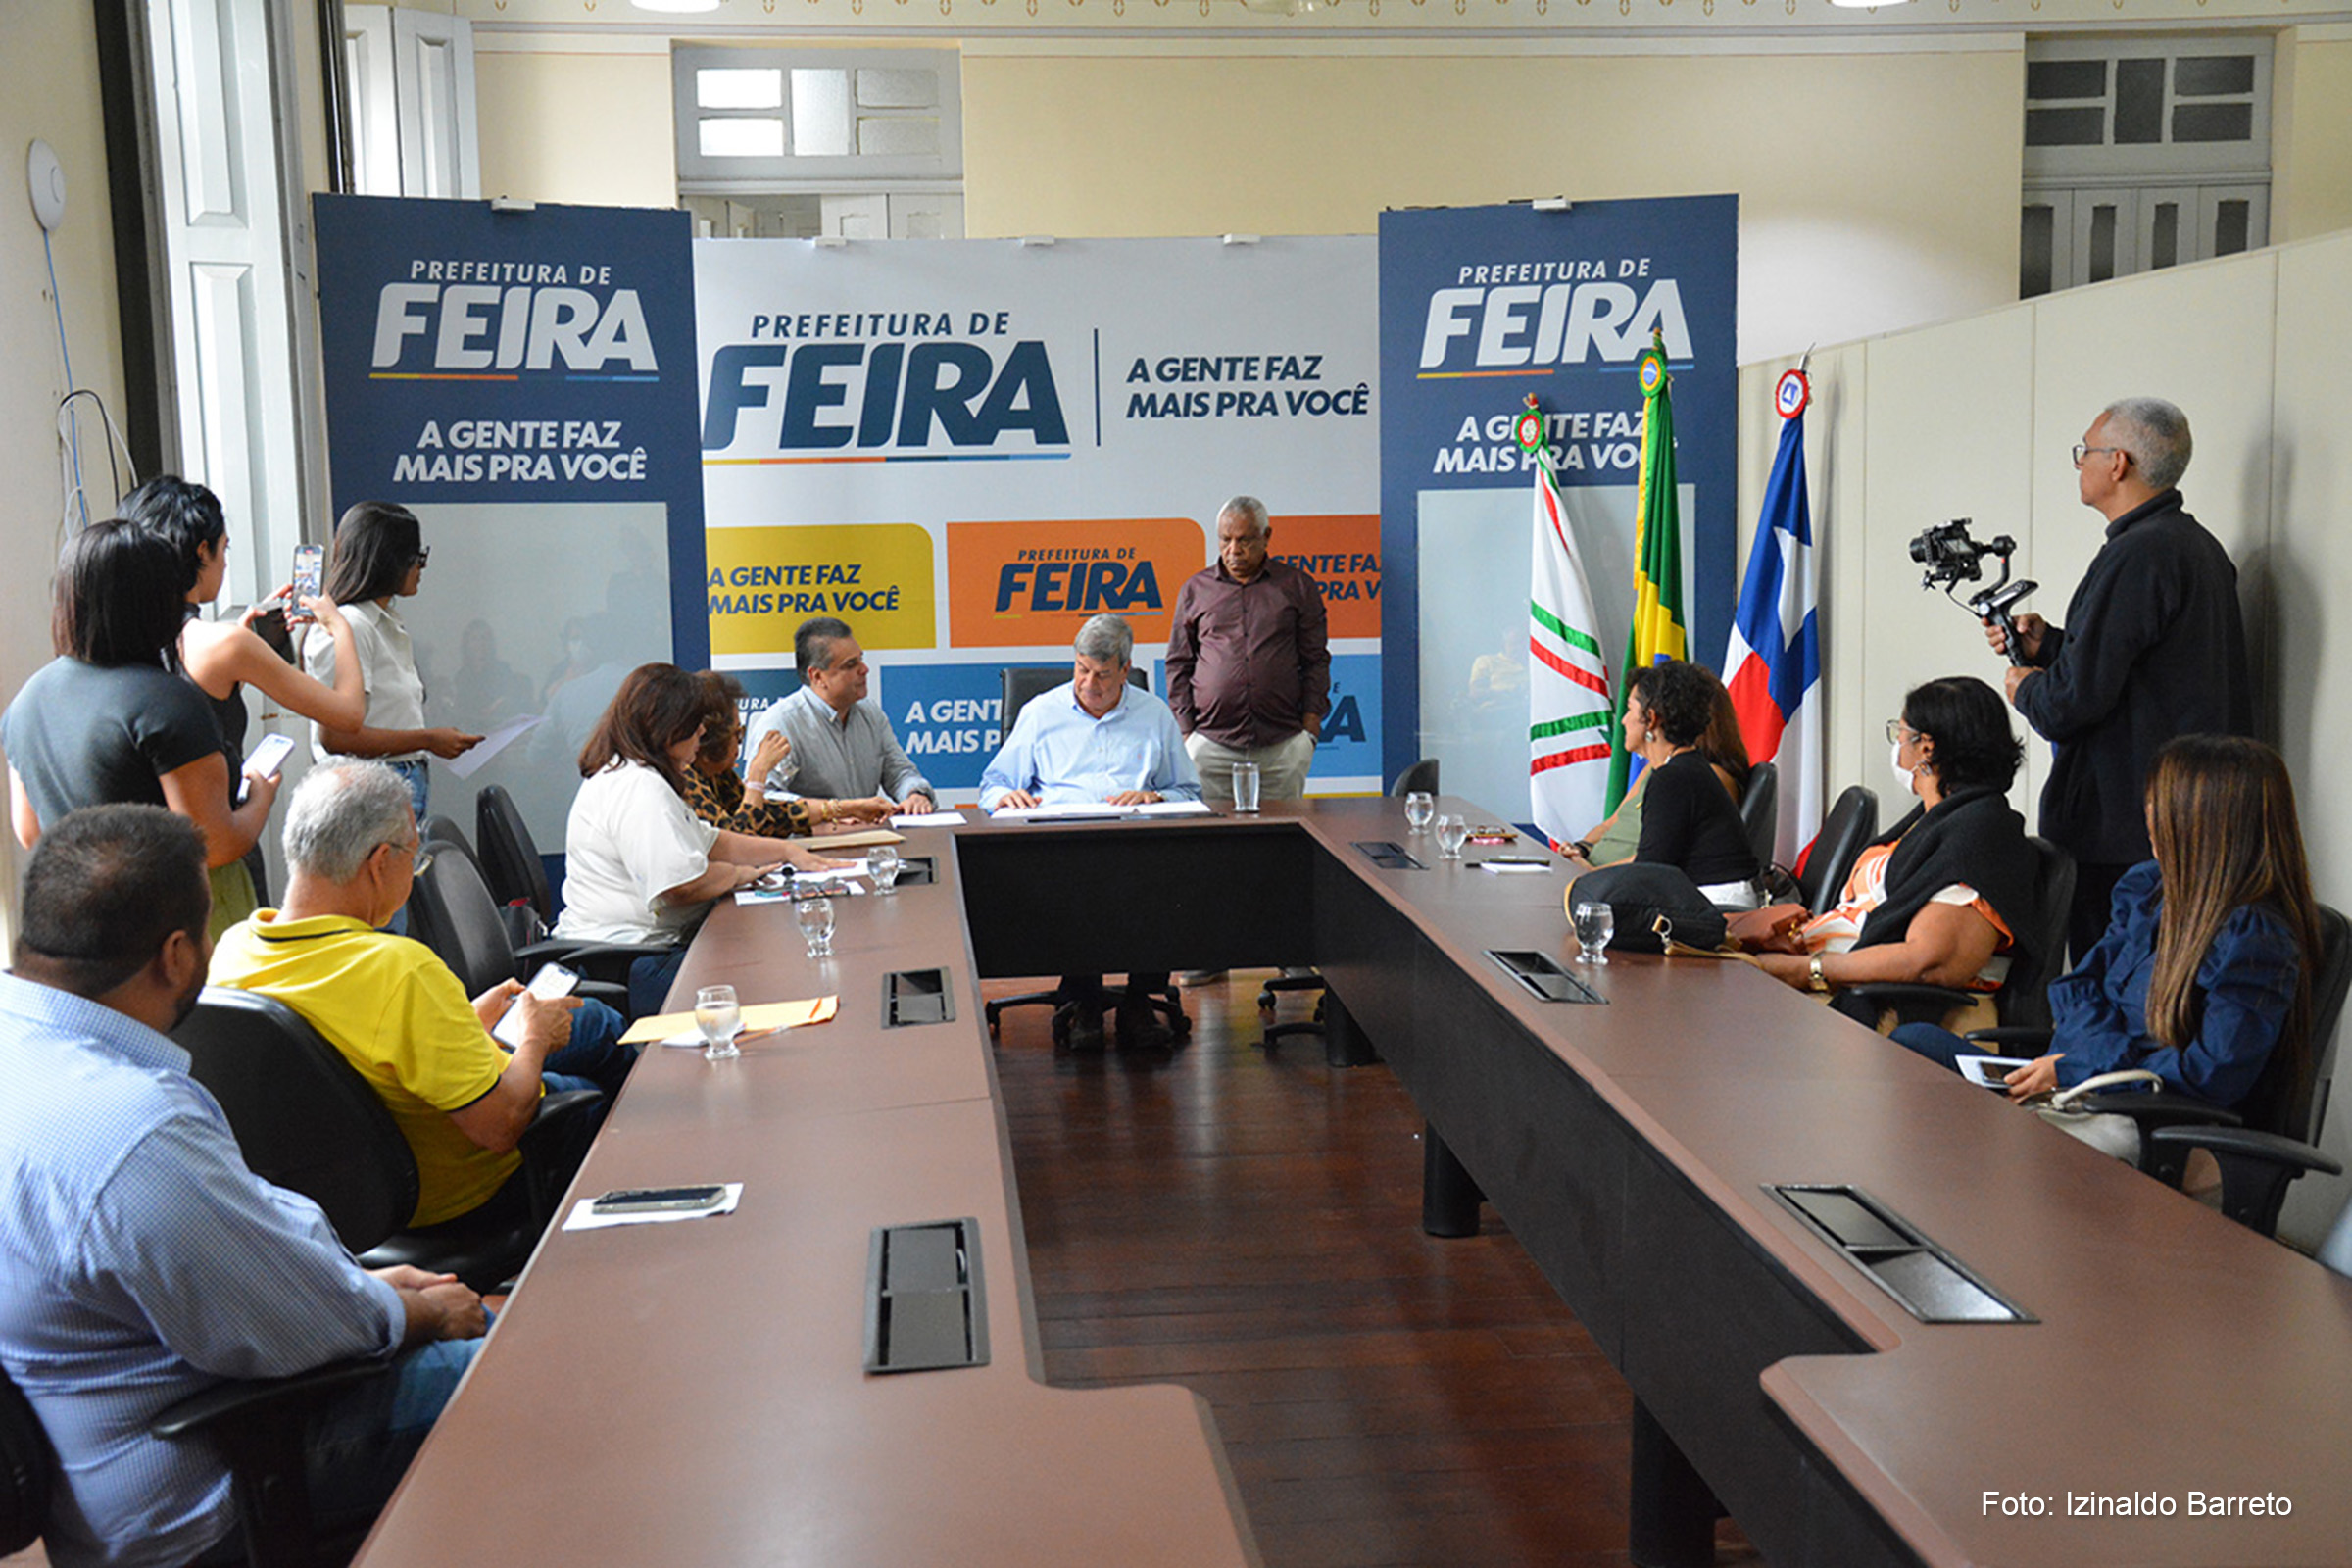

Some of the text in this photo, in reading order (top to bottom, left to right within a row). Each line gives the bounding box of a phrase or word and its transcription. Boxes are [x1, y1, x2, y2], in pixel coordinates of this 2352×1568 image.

[411, 260, 612, 285] PREFEITURA DE
[1458, 258, 1650, 284] PREFEITURA DE
[372, 282, 659, 371] FEIRA
[751, 311, 1009, 338] PREFEITURA DE
[1420, 279, 1694, 368] FEIRA
[1126, 355, 1323, 383] A GENTE FAZ
[702, 341, 1071, 451] FEIRA
[1126, 382, 1369, 418] MAIS PRA VOCÊ
[416, 421, 621, 449] A GENTE FAZ
[1456, 416, 1480, 441] A
[393, 446, 647, 482] MAIS PRA VOCÊ
[1433, 446, 1516, 473] MAIS
[1018, 547, 1136, 561] PREFEITURA DE
[1349, 554, 1381, 573] FA
[708, 564, 862, 587] A GENTE FAZ
[995, 561, 1163, 612] FEIRA
[709, 585, 900, 614] MAIS PRA VOCÊ
[904, 699, 1003, 723] A GENT
[905, 730, 979, 754] MAIS
